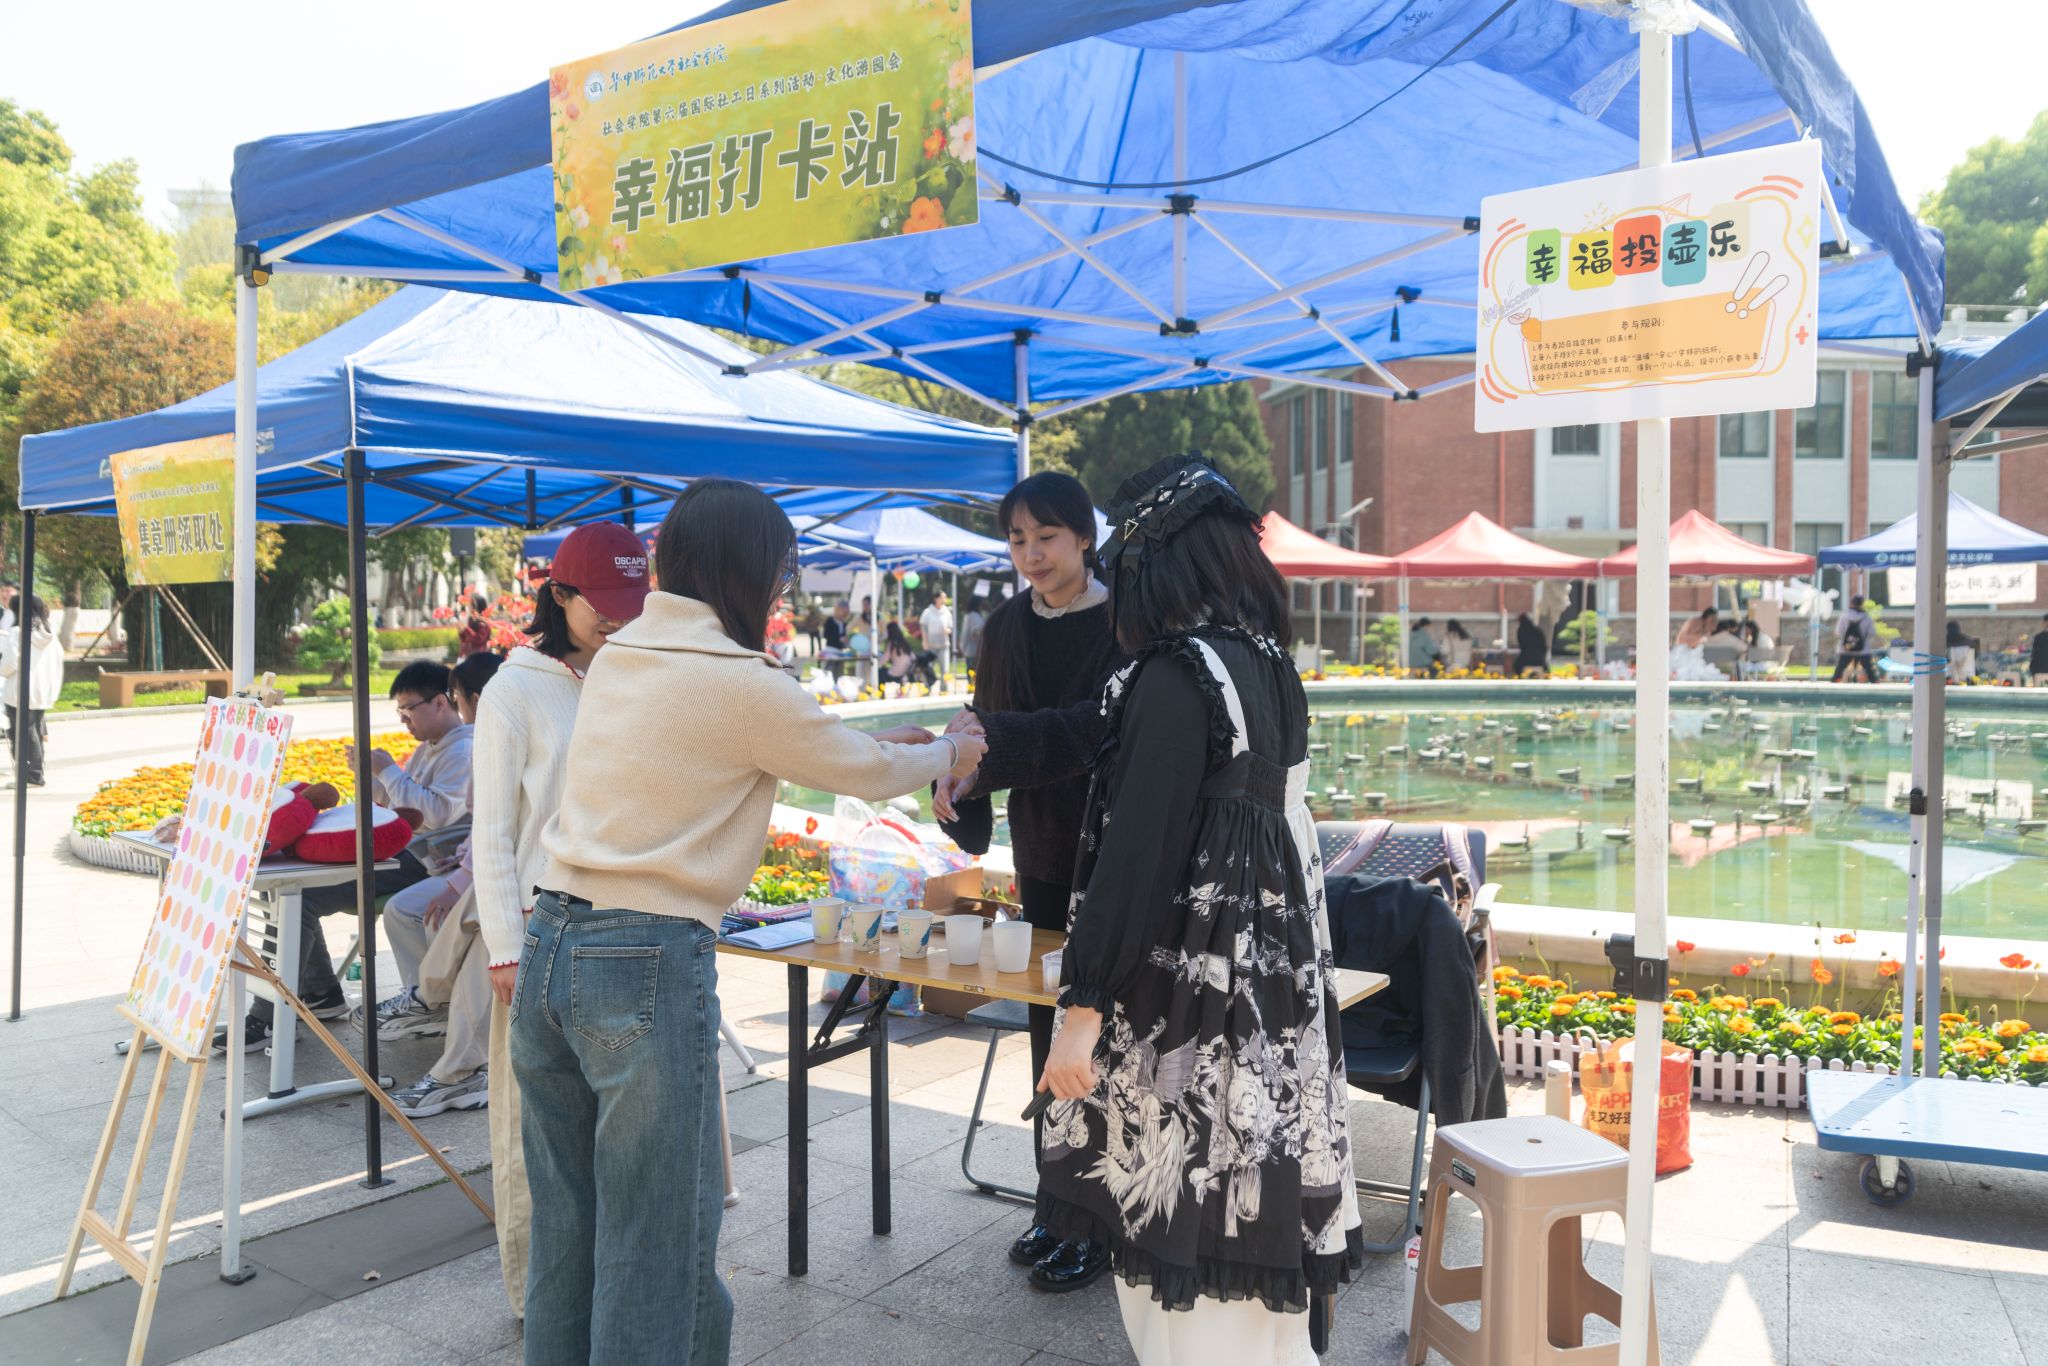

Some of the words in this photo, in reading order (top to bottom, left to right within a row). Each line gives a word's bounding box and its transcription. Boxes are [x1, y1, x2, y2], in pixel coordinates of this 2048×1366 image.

[611, 102, 902, 233] 幸福打卡站
[1529, 219, 1741, 283] 幸福投壶乐
[1482, 285, 1540, 324] Welcome
[138, 511, 225, 557] 集章册领取处
